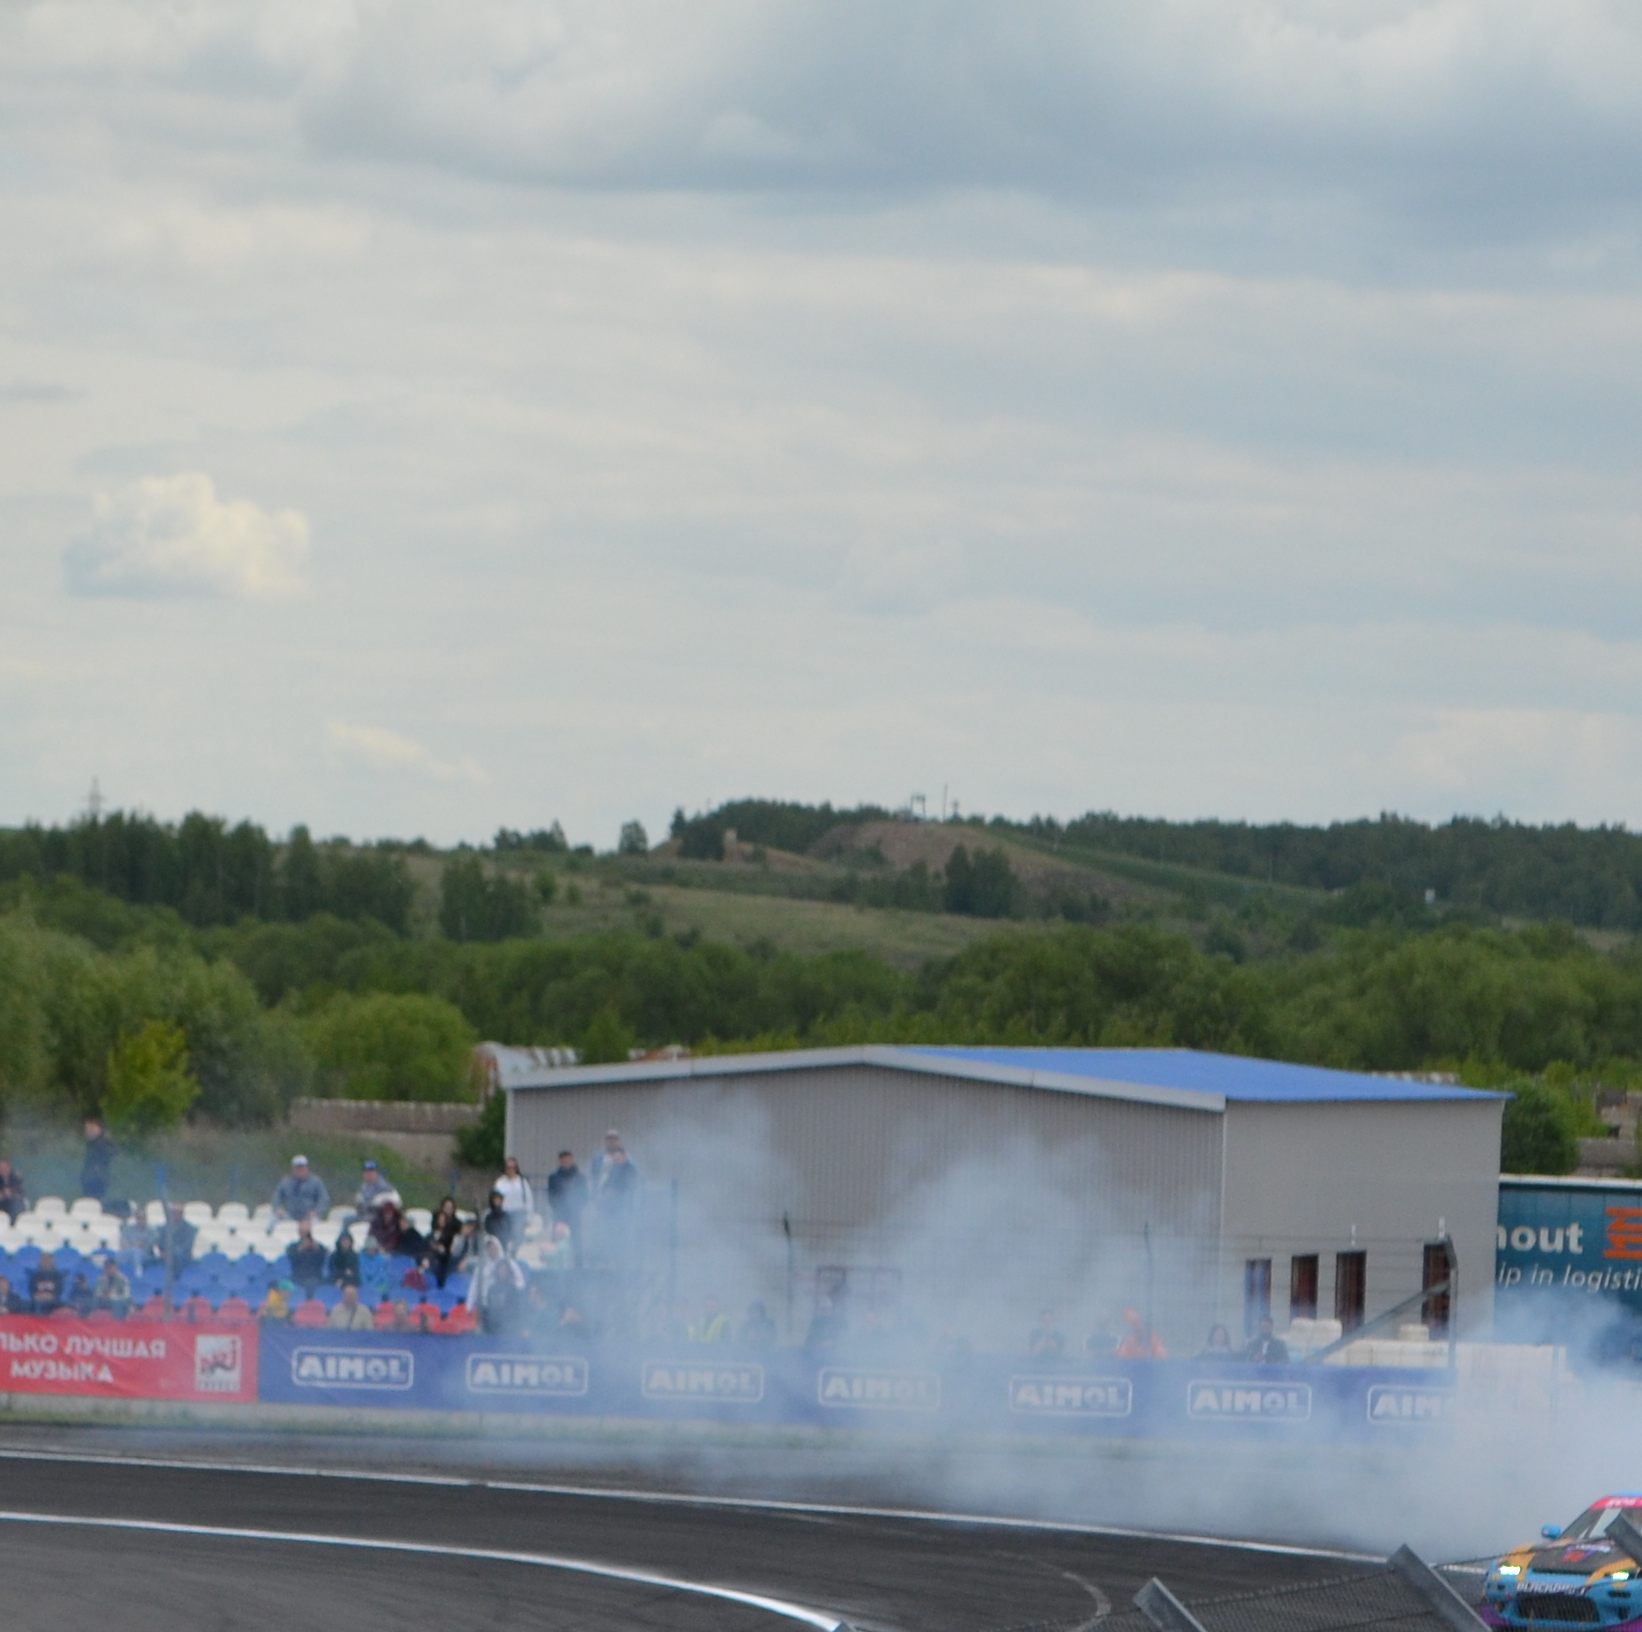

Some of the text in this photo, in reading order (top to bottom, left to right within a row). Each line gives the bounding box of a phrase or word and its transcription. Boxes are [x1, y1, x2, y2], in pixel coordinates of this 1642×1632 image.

[1531, 1264, 1554, 1286] in
[64, 1335, 167, 1360] ЛУЧШАЯ
[11, 1358, 114, 1383] МУЗЫКА
[298, 1355, 406, 1381] AIMOL
[472, 1361, 577, 1387] AIMOL
[648, 1369, 754, 1394] AIMOL
[1015, 1384, 1120, 1409] AIMOL
[1191, 1388, 1299, 1413] AIMOL
[1371, 1393, 1446, 1419] AIM
